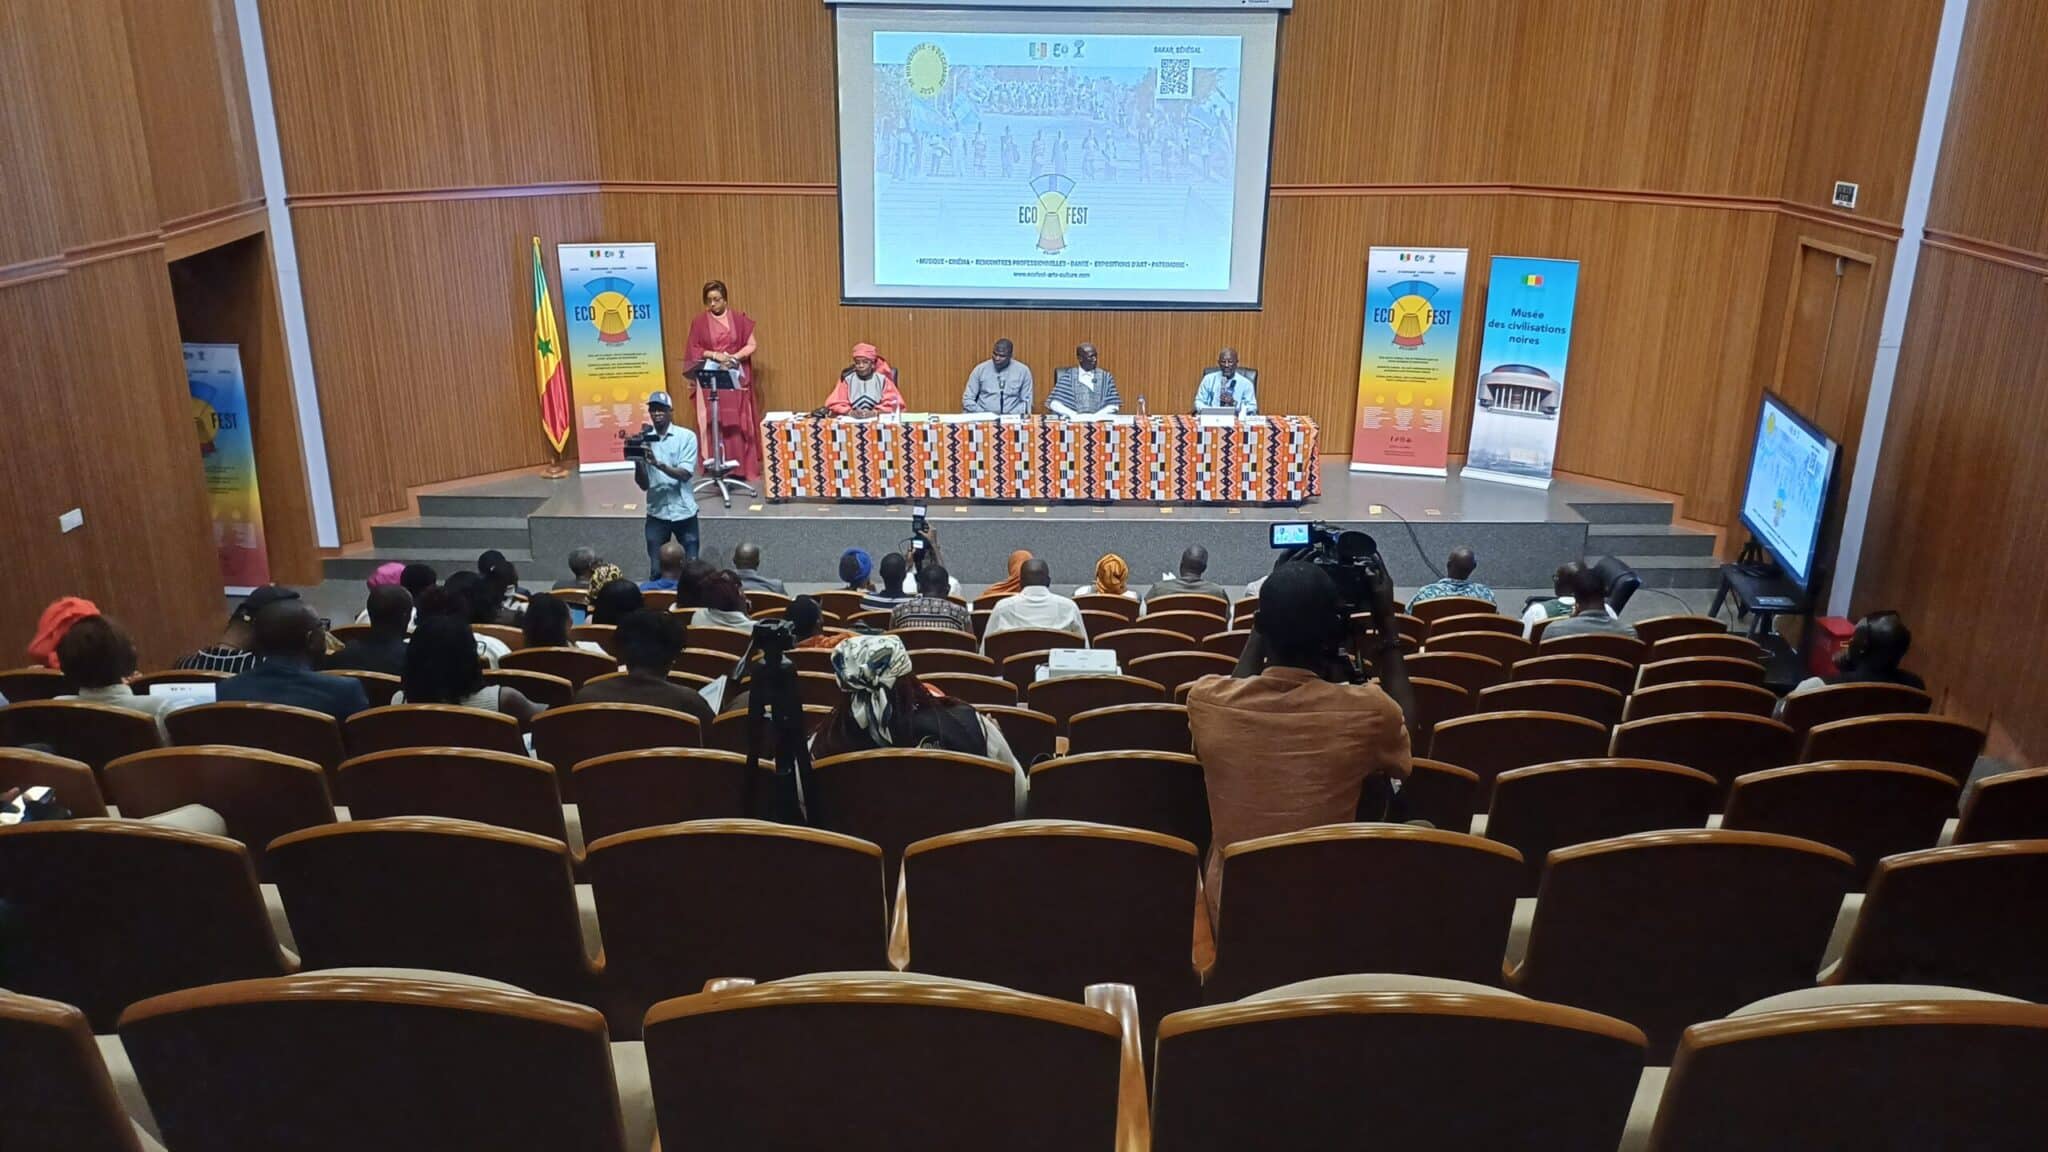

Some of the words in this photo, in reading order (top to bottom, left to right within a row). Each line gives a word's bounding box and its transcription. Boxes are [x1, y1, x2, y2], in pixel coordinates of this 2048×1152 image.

[1018, 206, 1038, 224] ECO
[1066, 207, 1088, 224] FEST
[574, 306, 596, 321] ECO
[626, 304, 651, 320] FEST
[1373, 308, 1395, 323] ECO
[1426, 309, 1452, 325] FEST
[1511, 308, 1544, 319] Musée
[1488, 319, 1505, 329] des
[1507, 321, 1566, 334] civilisations
[1509, 335, 1539, 345] noires
[211, 413, 237, 429] FEST
